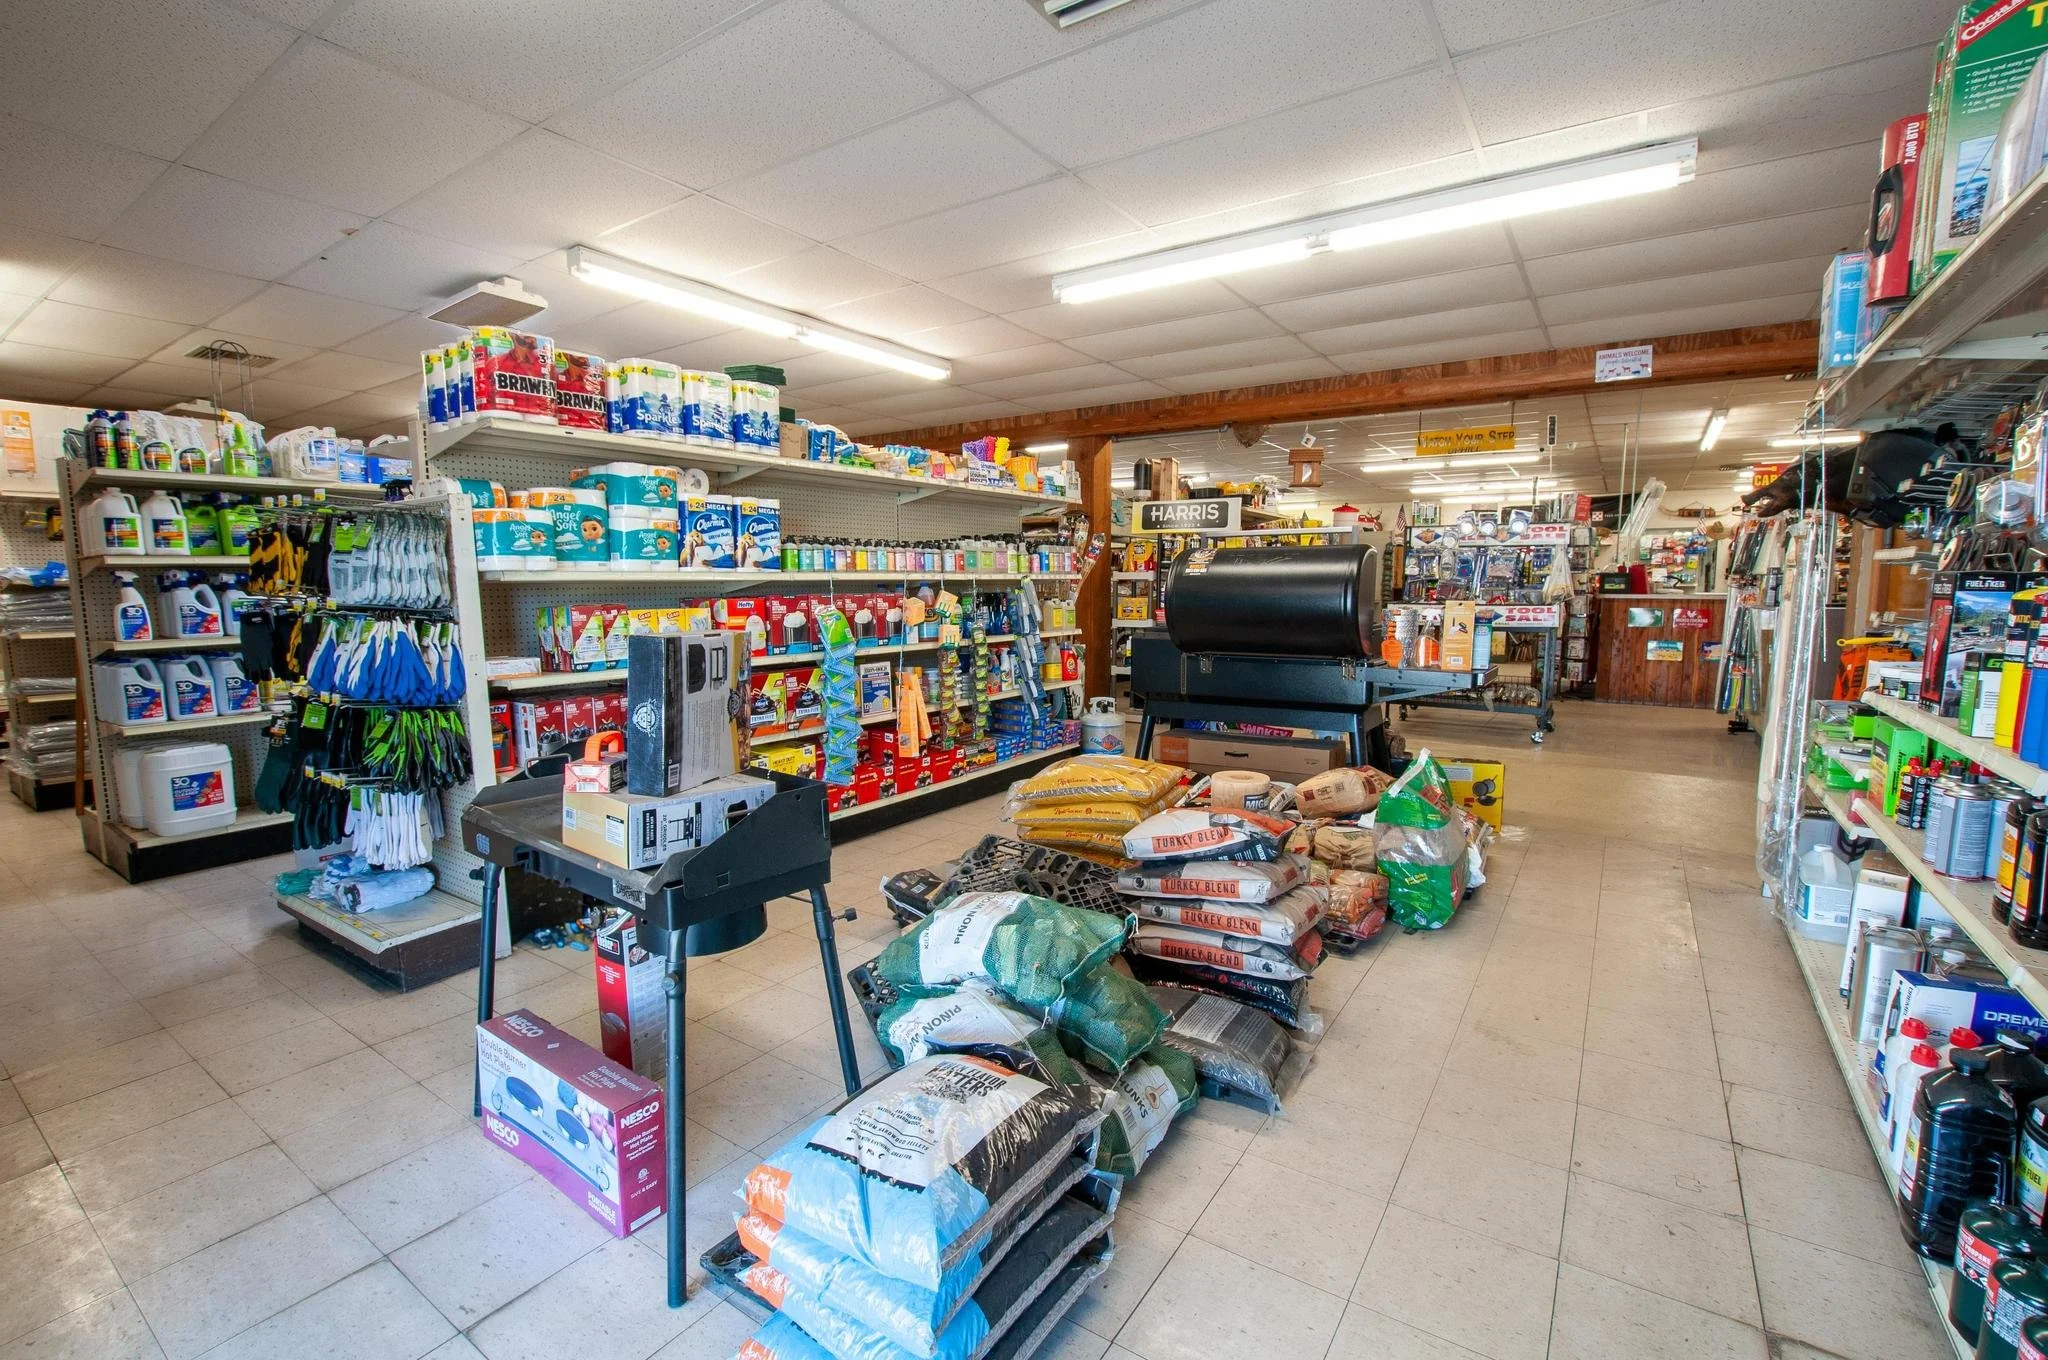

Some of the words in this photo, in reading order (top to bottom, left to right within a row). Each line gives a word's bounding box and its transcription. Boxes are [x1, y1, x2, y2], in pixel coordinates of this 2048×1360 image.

[1905, 122, 1920, 140] BTU
[636, 409, 679, 428] Sparkle
[743, 423, 776, 440] Sparkle
[550, 508, 581, 522] Angel
[706, 503, 726, 511] MEGA
[758, 507, 776, 515] MEGA
[1151, 504, 1220, 521] HARRIS
[556, 519, 578, 532] Soft
[697, 518, 725, 530] Charmin
[749, 522, 775, 534] Charmin
[126, 607, 143, 615] 30
[181, 606, 197, 614] 30
[738, 601, 754, 609] Hefty
[126, 686, 143, 694] 30
[176, 682, 193, 690] 30
[226, 678, 241, 687] 30
[172, 777, 190, 787] 30
[1156, 833, 1193, 849] TURKEY
[1198, 826, 1230, 840] BLEND
[1164, 879, 1200, 892] TURKEY
[1205, 881, 1236, 894] BLEND
[1185, 911, 1222, 926] TURKEY
[1226, 917, 1258, 932] BLEND
[1164, 944, 1204, 959] TURKEY
[1207, 952, 1240, 967] BLEND
[503, 1014, 544, 1038] NESCO
[479, 1033, 503, 1056] Double
[503, 1047, 528, 1071] Burner
[480, 1048, 493, 1062] Hot
[493, 1054, 512, 1073] Plate
[588, 1070, 600, 1081] Hot
[967, 1065, 1007, 1090] FLAVOR
[619, 1076, 642, 1093] Burner
[621, 1101, 660, 1129] NESCO
[486, 1114, 519, 1147] NESCO
[622, 1133, 642, 1147] Double
[642, 1124, 659, 1138] Burner
[629, 1140, 640, 1150] Hot
[640, 1134, 654, 1147] Plate
[2026, 1168, 2042, 1186] FUEL
[588, 1191, 616, 1219] PORTABLE
